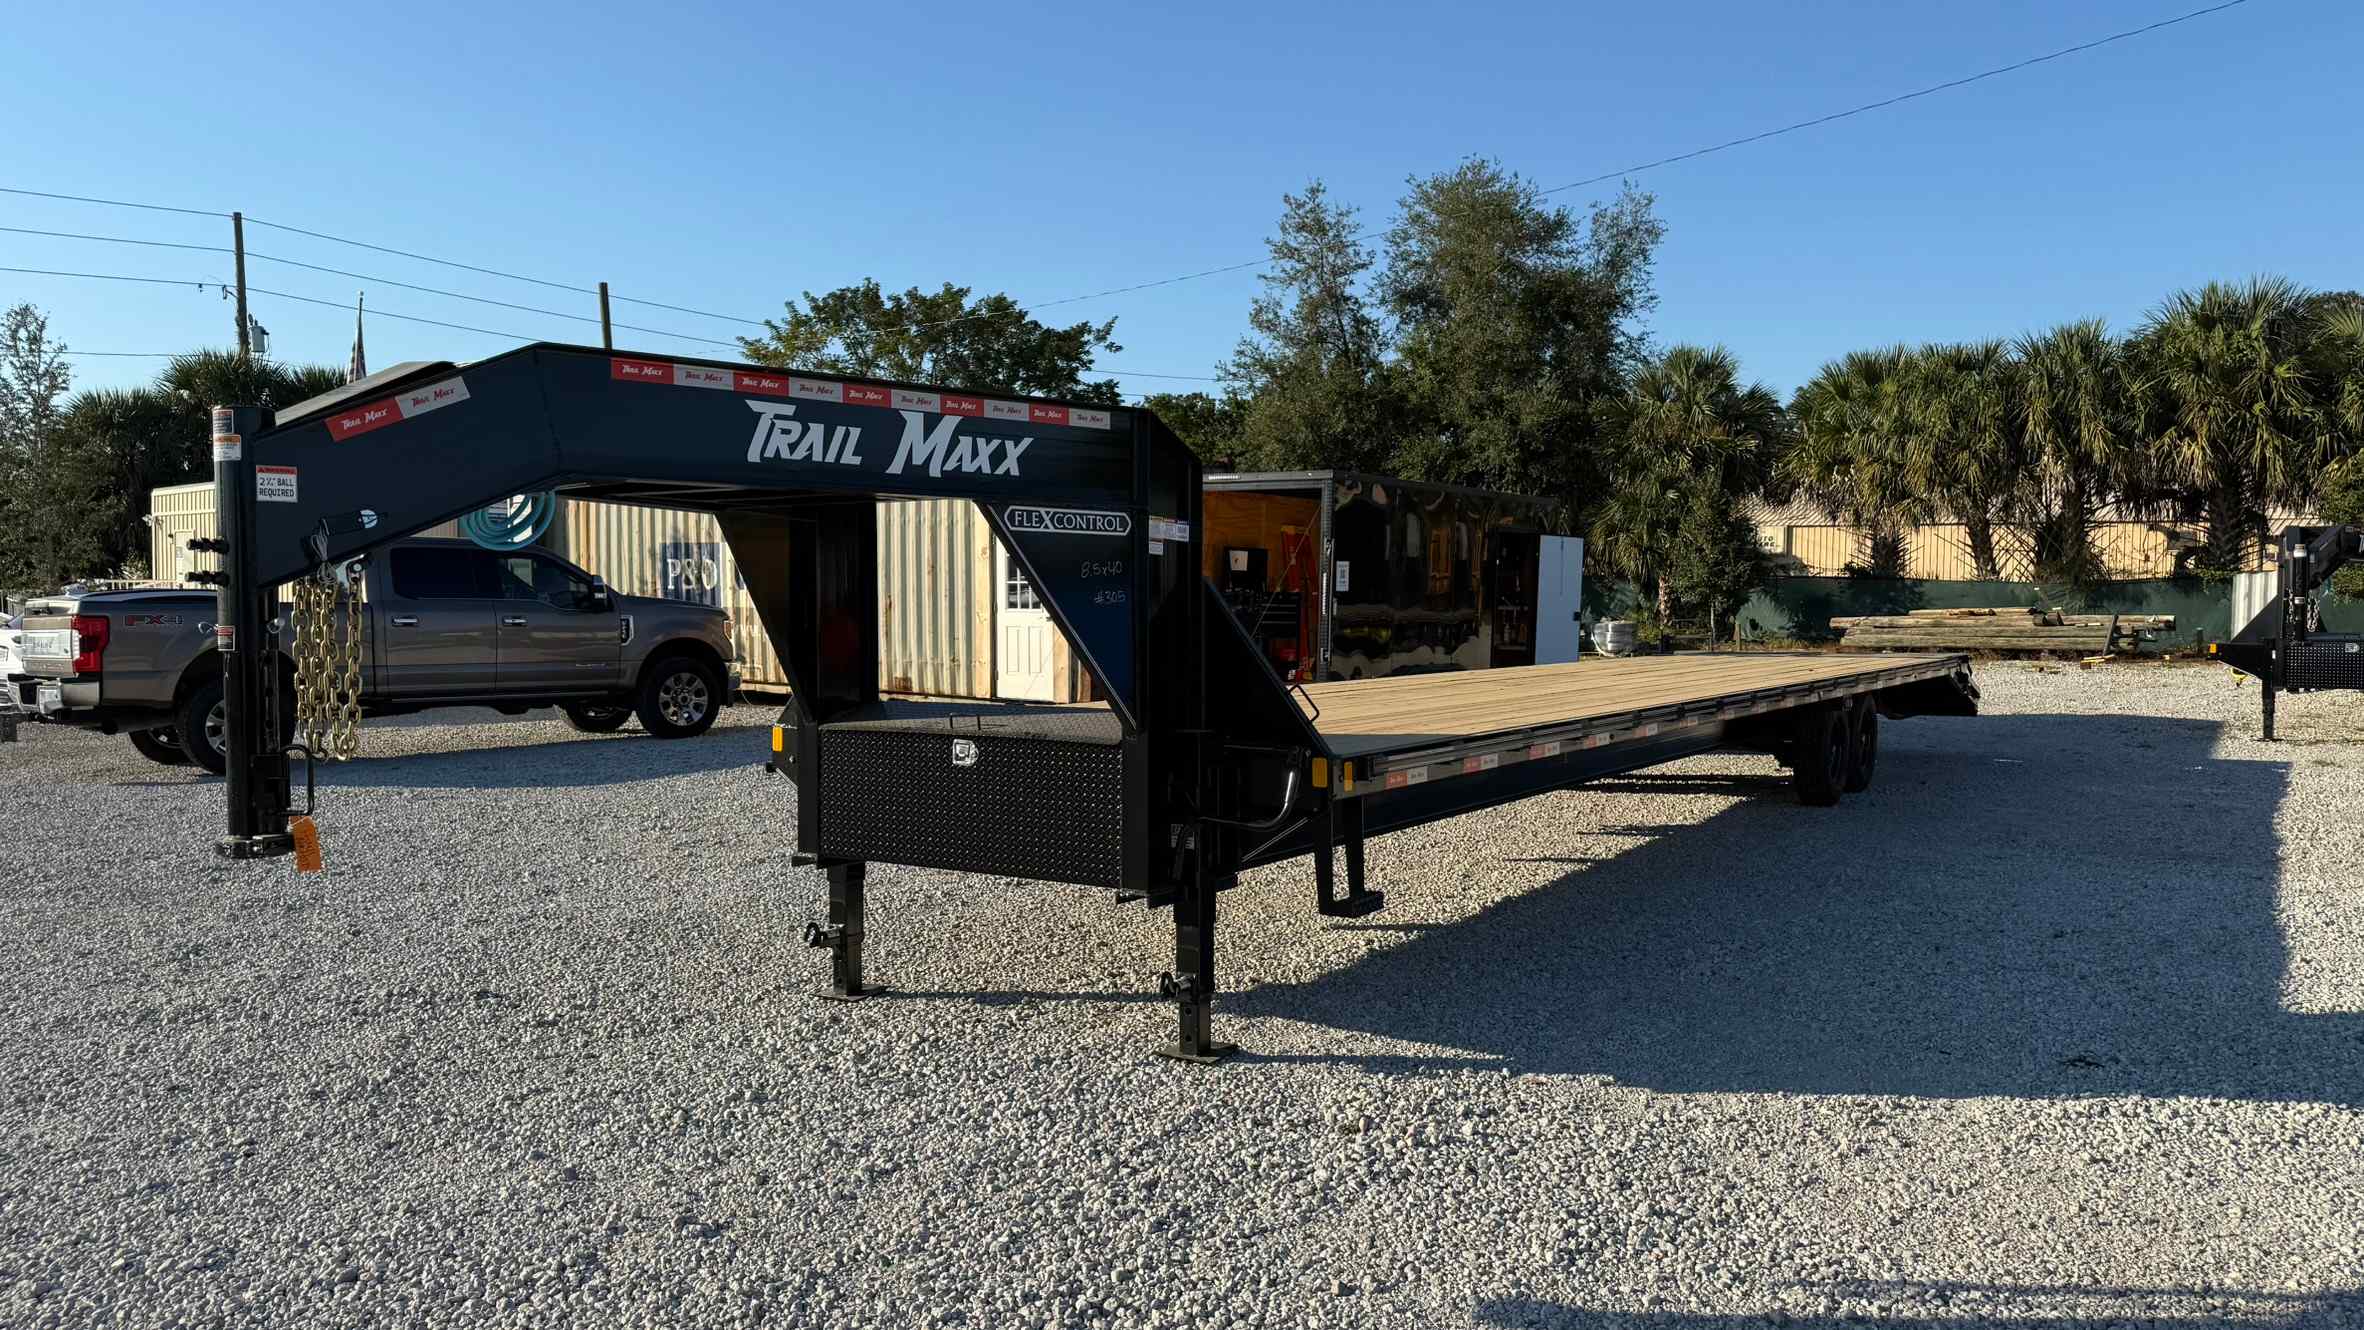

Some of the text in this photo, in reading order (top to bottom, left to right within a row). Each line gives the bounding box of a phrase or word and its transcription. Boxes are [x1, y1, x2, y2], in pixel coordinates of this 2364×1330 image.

[745, 399, 1035, 478] TRAIL MAXX
[259, 487, 295, 499] REQUIRED
[277, 477, 295, 487] BALL
[1014, 508, 1125, 533] FLEXCONTROL
[667, 558, 718, 591] P&O
